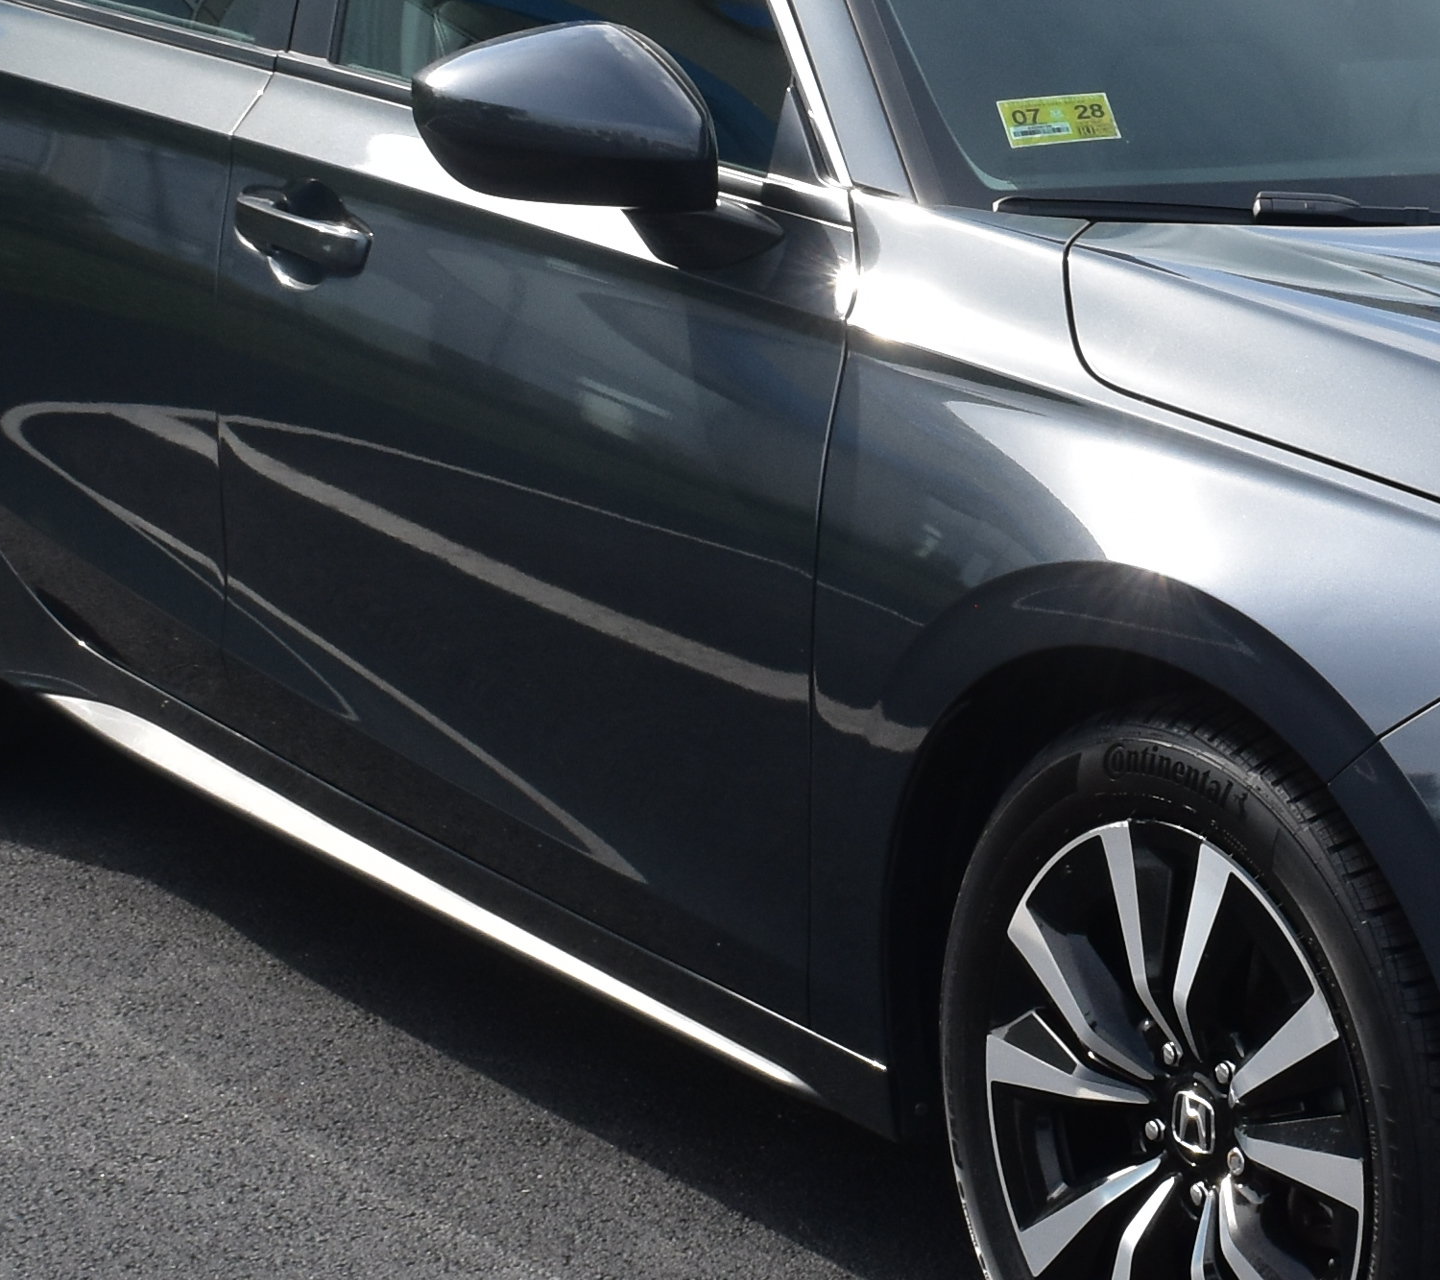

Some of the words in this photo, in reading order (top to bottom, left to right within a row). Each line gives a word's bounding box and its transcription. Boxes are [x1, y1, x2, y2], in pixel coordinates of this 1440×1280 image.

[1011, 107, 1040, 125] 07
[1073, 103, 1105, 120] 28
[1103, 741, 1234, 808] Continental
